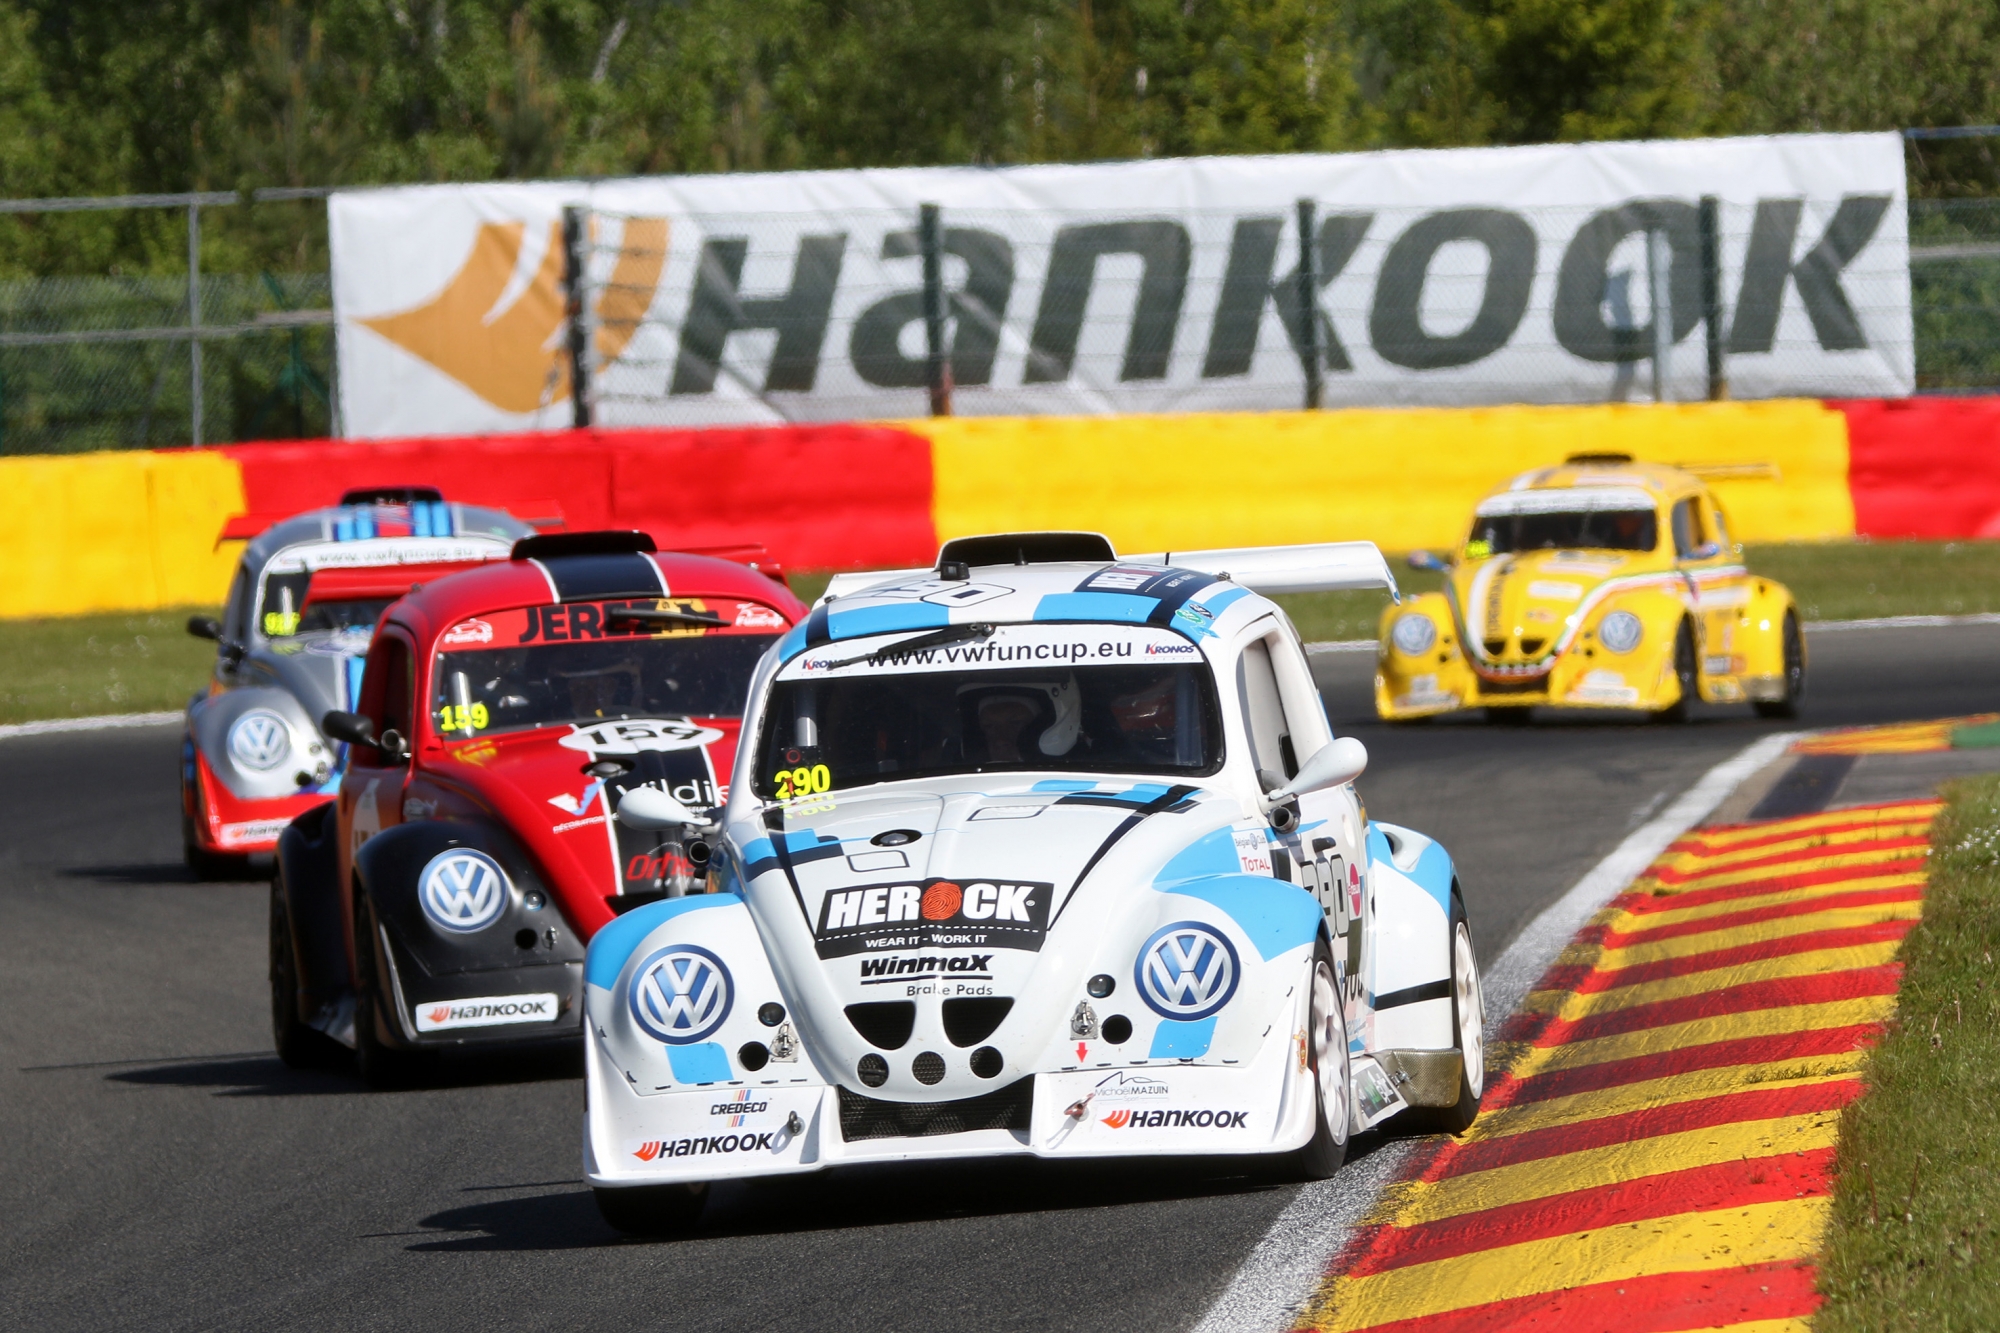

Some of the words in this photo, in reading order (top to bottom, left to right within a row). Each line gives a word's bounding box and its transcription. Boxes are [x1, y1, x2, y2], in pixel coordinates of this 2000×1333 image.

[866, 640, 1132, 669] www.vwfuncup.eu
[1144, 641, 1195, 655] KRONOS
[440, 704, 490, 732] 159
[584, 726, 704, 746] 159
[774, 764, 831, 799] 290
[1241, 856, 1271, 873] TOTAL
[865, 937, 904, 948] WEAR
[908, 936, 919, 945] IT
[931, 934, 971, 944] WORK
[975, 935, 987, 943] IT
[956, 984, 993, 996] Pads
[710, 1102, 767, 1115] CREDECO
